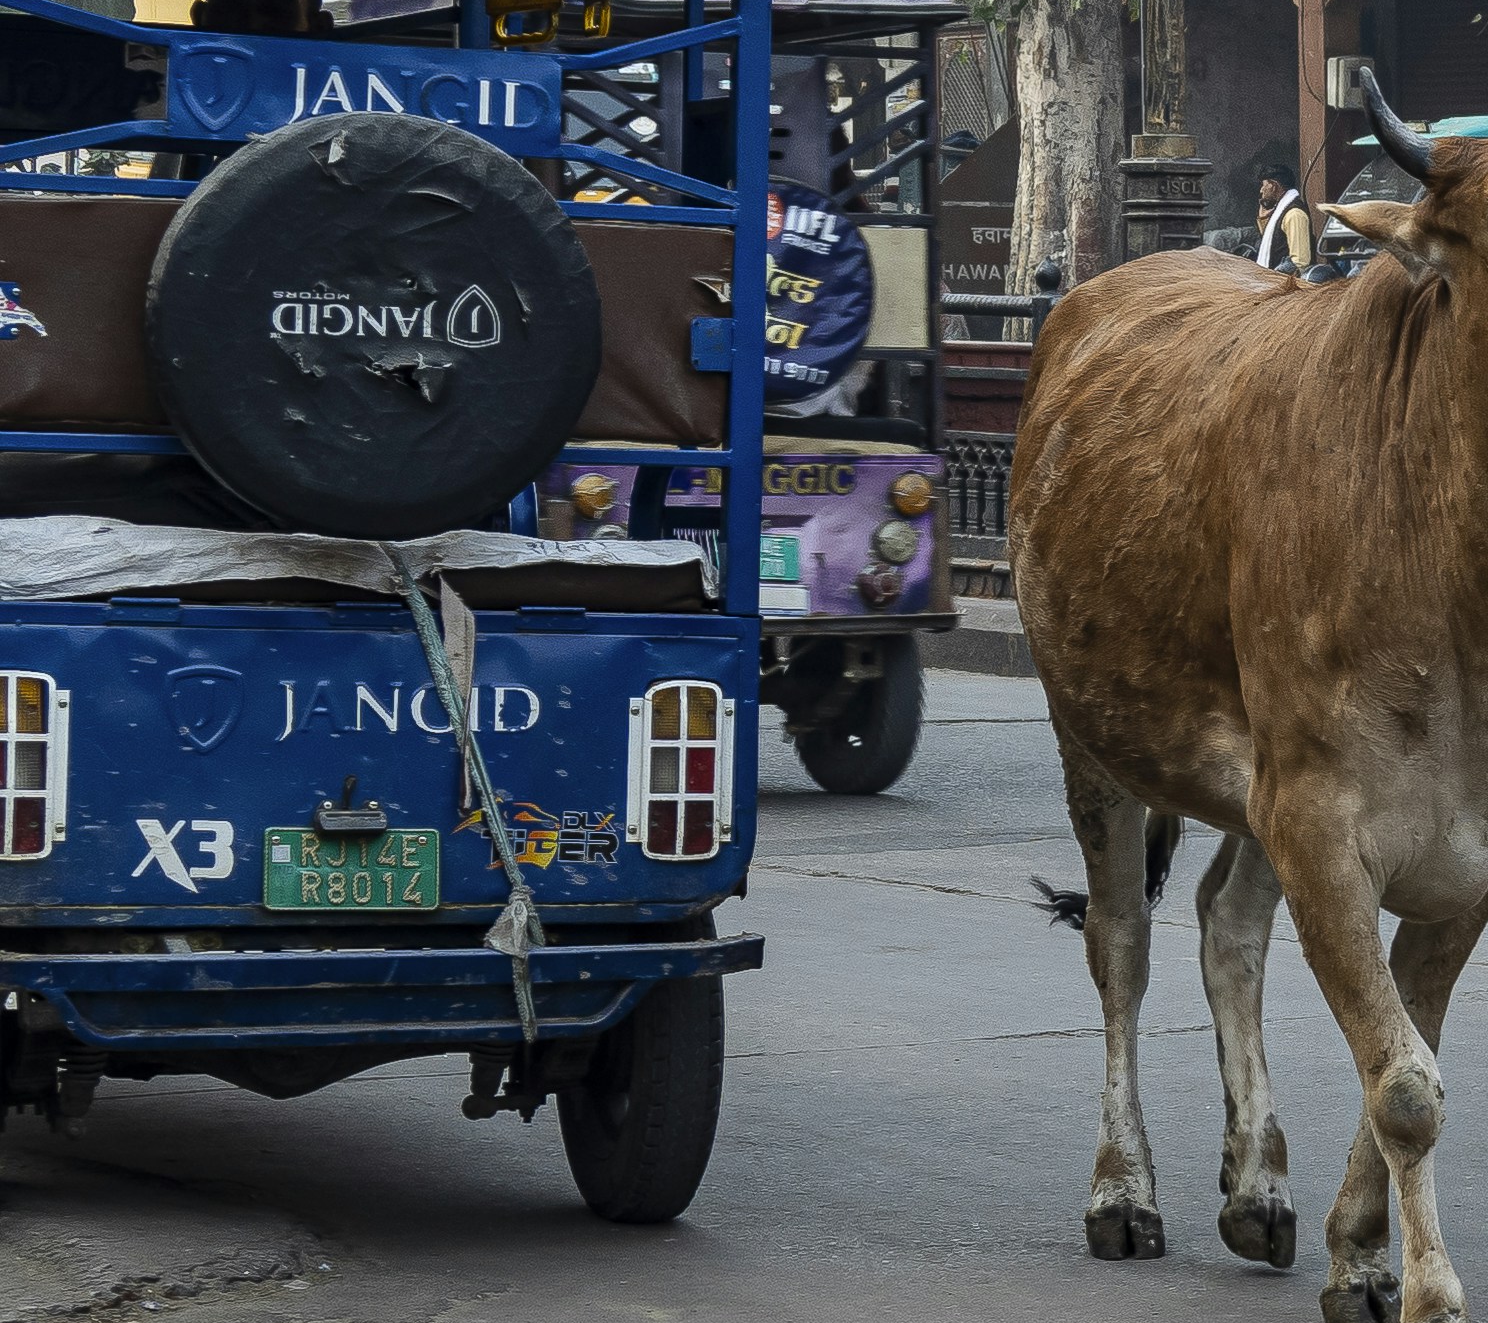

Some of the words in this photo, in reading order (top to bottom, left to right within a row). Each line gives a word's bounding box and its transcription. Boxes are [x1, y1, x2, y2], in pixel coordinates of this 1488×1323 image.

[288, 62, 551, 127] JANGID
[272, 290, 350, 300] MOTORS
[273, 300, 438, 338] JANGID
[563, 810, 616, 832] DLX
[131, 819, 234, 894] X3
